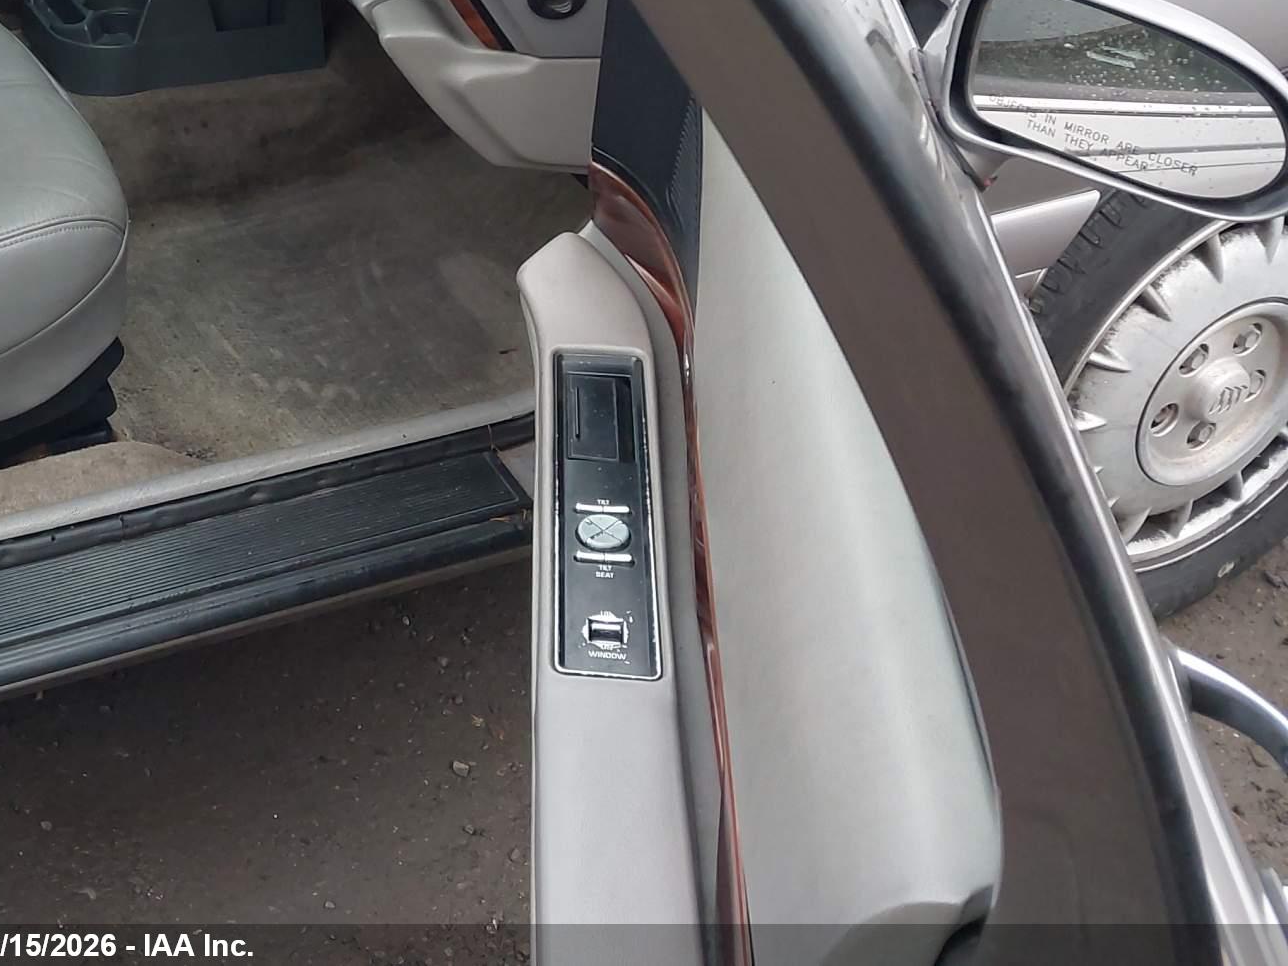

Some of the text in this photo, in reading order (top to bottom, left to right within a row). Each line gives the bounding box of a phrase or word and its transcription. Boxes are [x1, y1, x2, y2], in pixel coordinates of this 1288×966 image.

[989, 94, 1198, 177] OBJECS IN MIRROR ARE CLOSER
[1027, 119, 1148, 171] THAN THEY APPEAR
[588, 650, 627, 660] WINDOW
